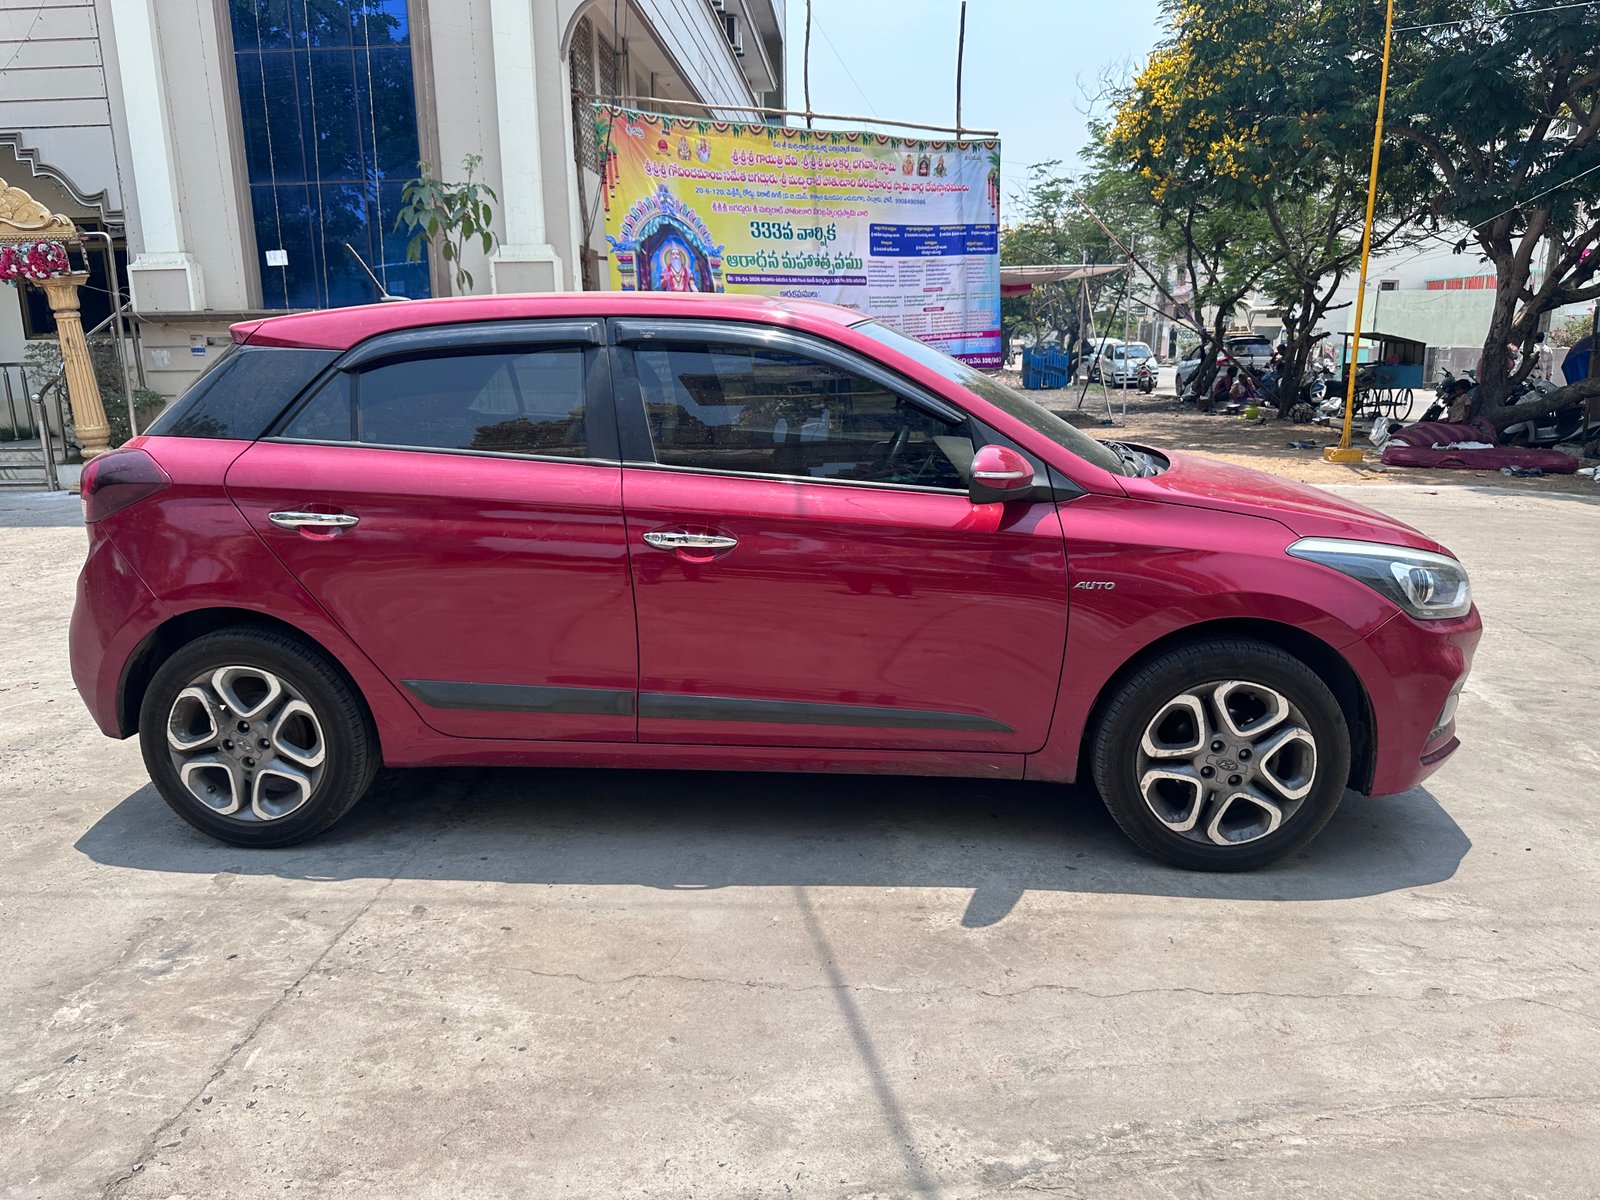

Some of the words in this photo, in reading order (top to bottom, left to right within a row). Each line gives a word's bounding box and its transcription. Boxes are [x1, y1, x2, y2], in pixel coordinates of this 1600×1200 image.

[780, 172, 788, 188] శ్రీ
[750, 220, 793, 240] 333వ
[797, 222, 837, 248] వార్షిక
[726, 249, 779, 272] ఆరాధన
[782, 250, 863, 275] మహోత్సవము
[1073, 581, 1116, 590] AUTO
